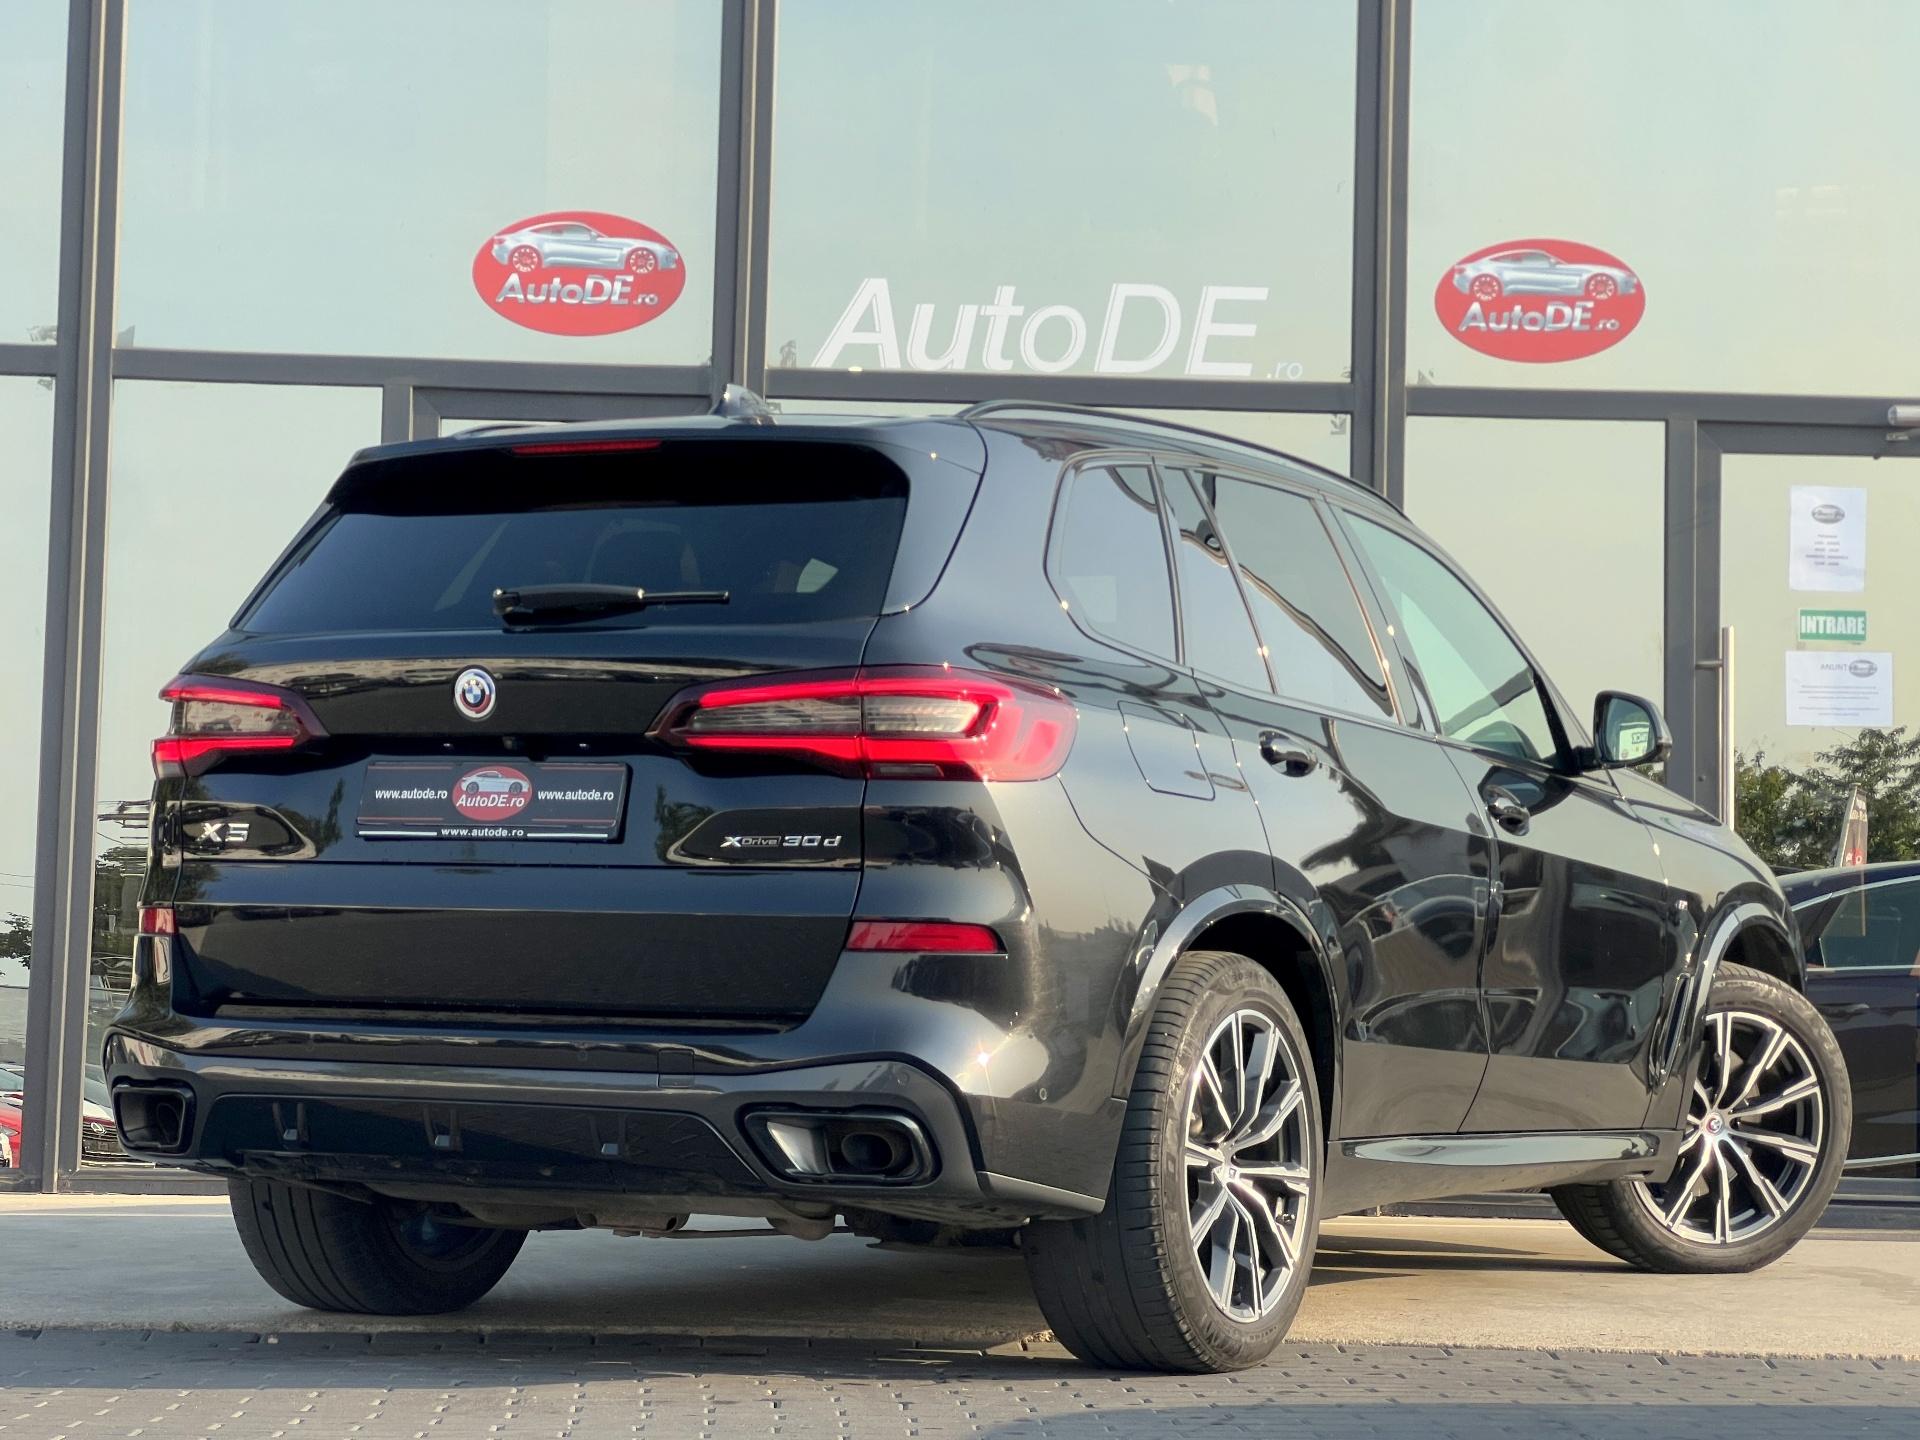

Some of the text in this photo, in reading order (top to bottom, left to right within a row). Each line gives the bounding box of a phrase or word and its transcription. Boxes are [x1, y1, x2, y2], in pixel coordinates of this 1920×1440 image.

[1800, 615, 1865, 635] INTRARE
[375, 788, 614, 808] www.autode.ro AutoDE.ro www.autode.ro
[196, 822, 250, 842] X5
[440, 826, 524, 838] www.autode.ro
